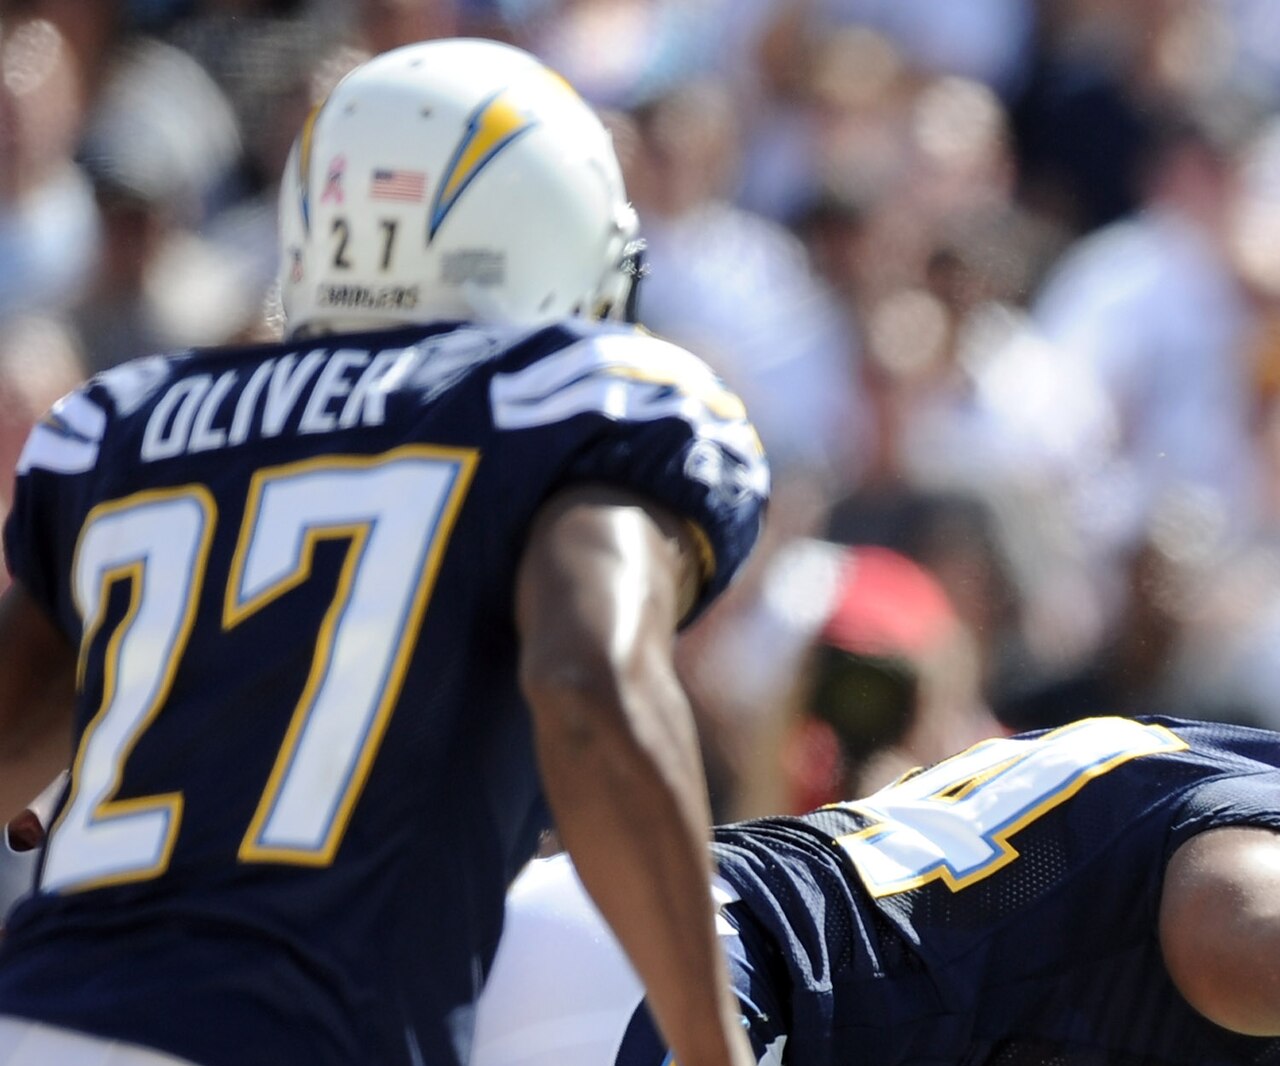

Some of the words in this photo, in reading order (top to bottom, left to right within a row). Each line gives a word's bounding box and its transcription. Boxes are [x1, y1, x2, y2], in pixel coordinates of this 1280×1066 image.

[331, 216, 399, 271] 27
[140, 347, 416, 463] OLIVER
[38, 444, 480, 893] 27
[823, 716, 1190, 898] 4
